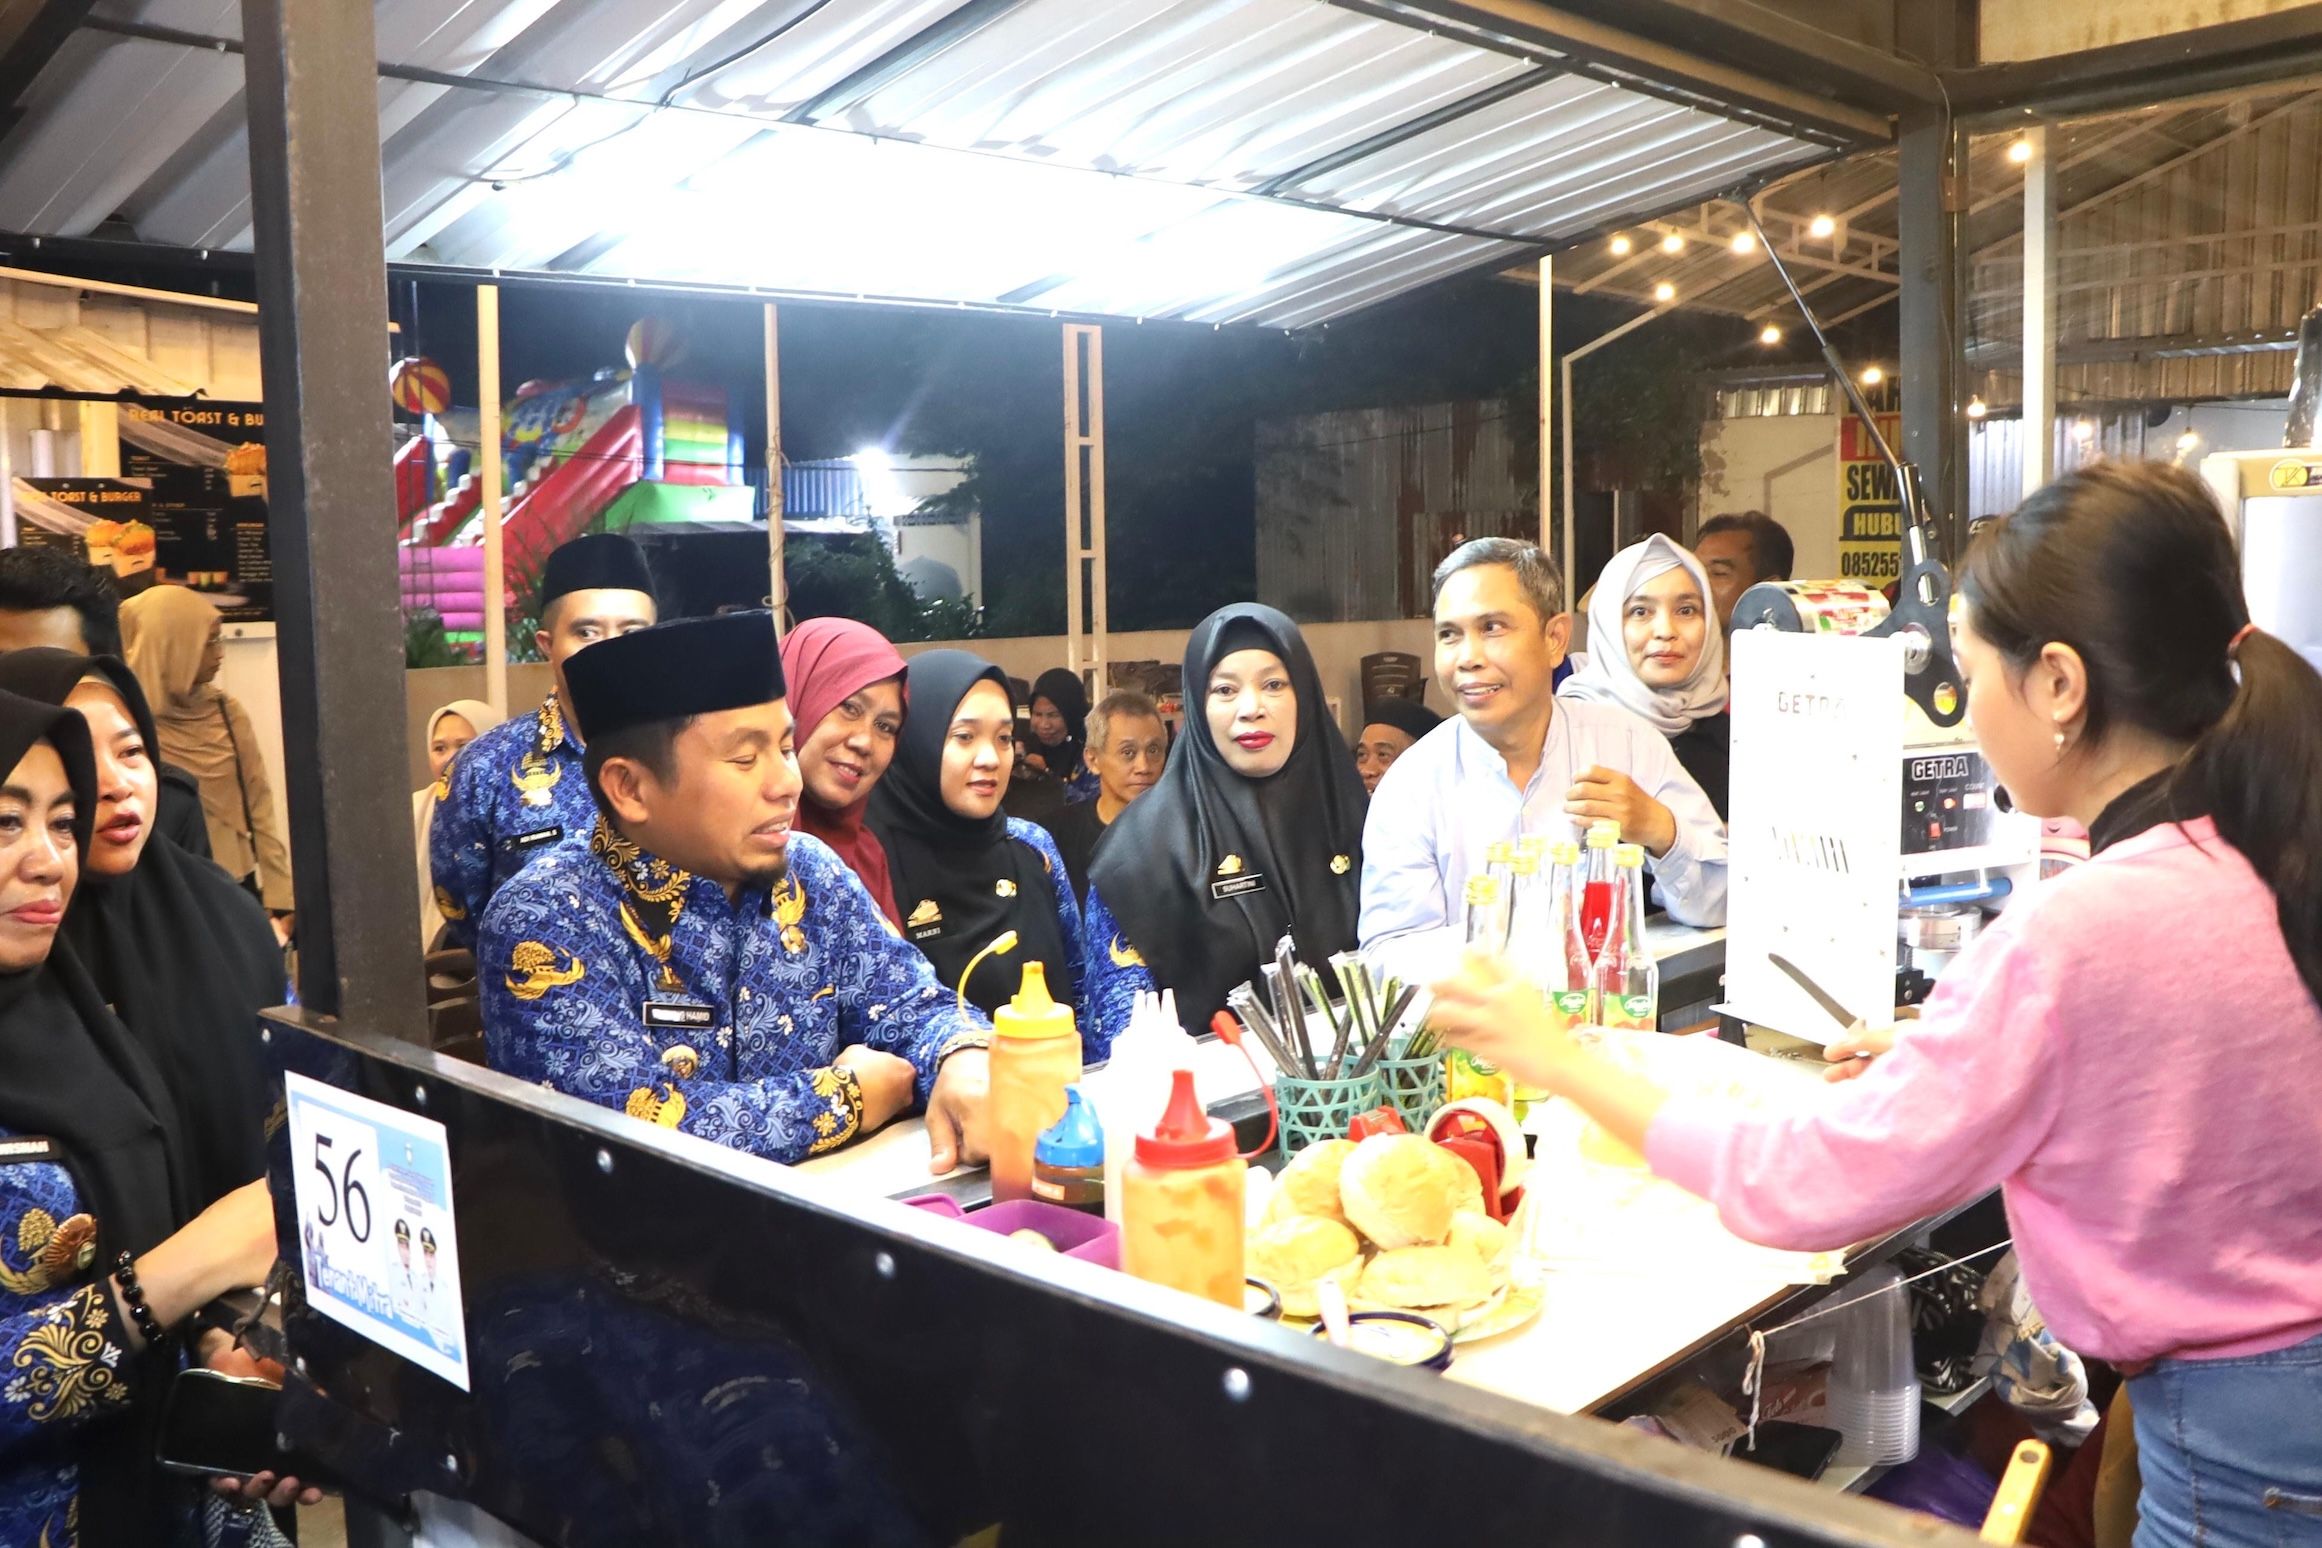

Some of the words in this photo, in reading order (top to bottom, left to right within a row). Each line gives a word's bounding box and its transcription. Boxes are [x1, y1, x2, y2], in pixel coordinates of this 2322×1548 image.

[128, 408, 166, 422] REAL
[171, 410, 223, 424] TOAST
[227, 413, 240, 427] &
[1847, 464, 1898, 501] SEW
[50, 491, 86, 503] TOAST
[89, 492, 98, 503] &
[101, 491, 142, 503] BURGER
[1841, 551, 1902, 577] 085255
[1912, 756, 1969, 781] GETRA
[314, 1132, 371, 1244] 56
